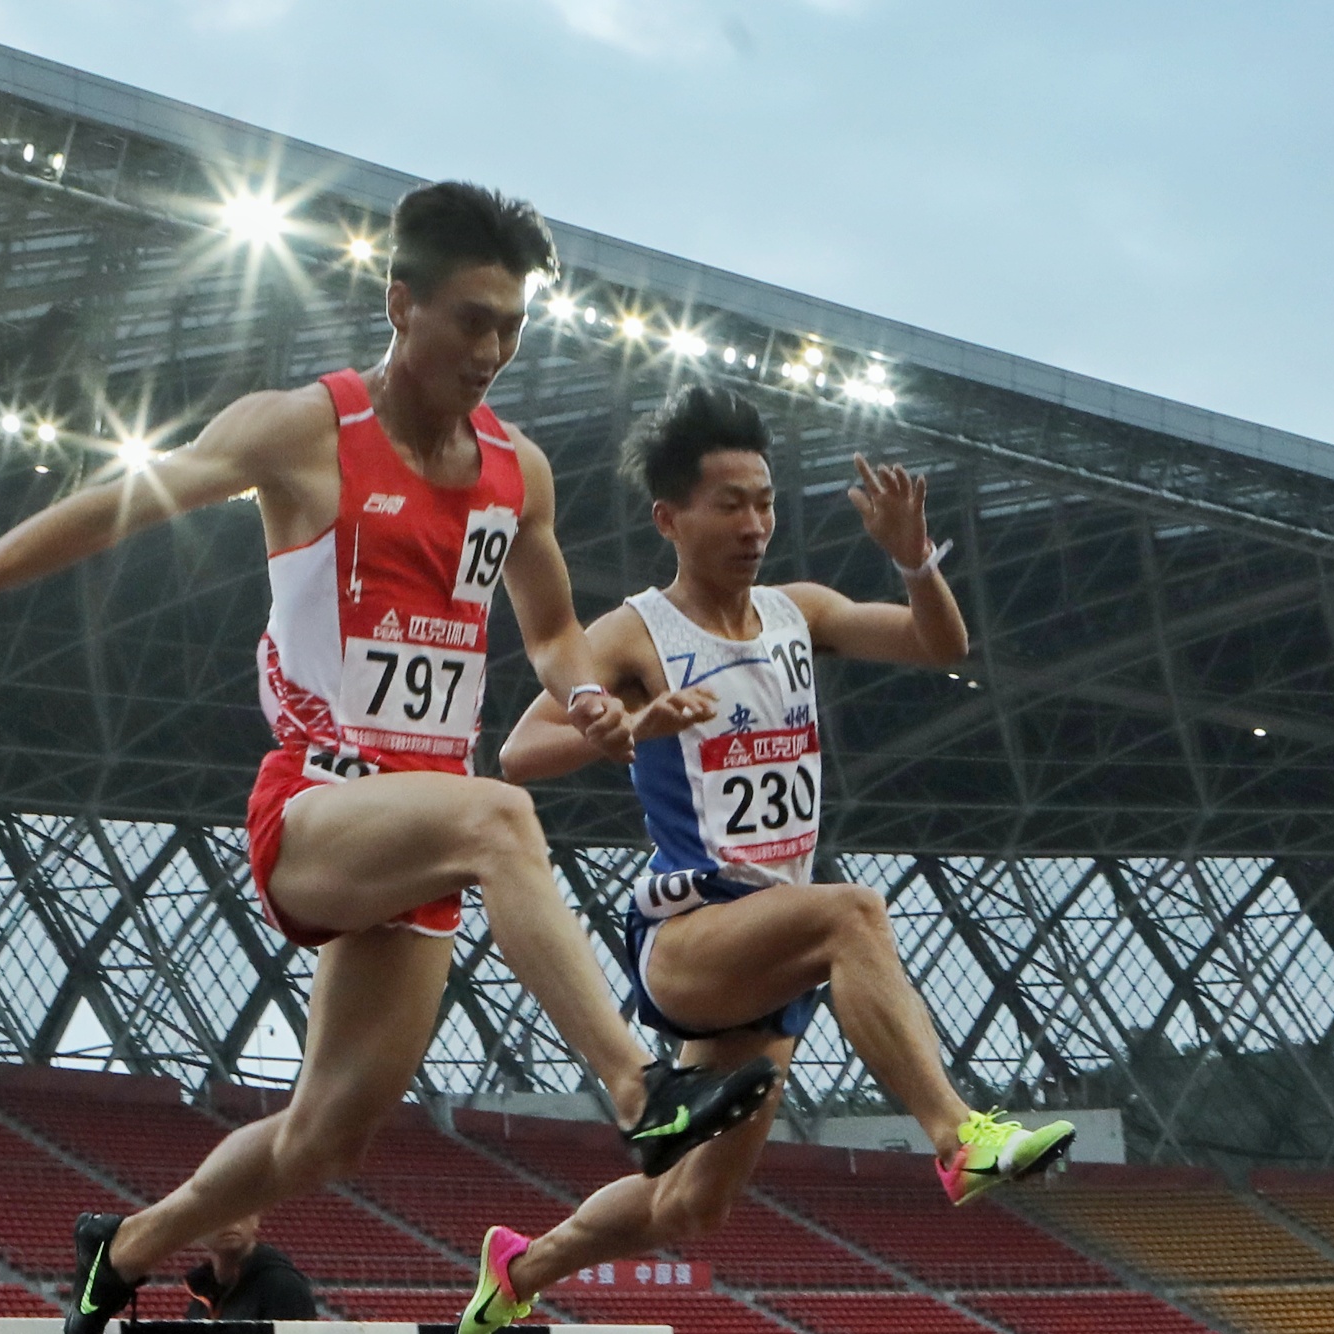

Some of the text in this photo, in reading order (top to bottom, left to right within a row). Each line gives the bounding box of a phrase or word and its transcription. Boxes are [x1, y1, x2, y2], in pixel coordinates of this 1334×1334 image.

[464, 526, 509, 588] 19
[373, 624, 405, 641] PEAK
[408, 615, 479, 648] 匹克体育
[366, 650, 465, 724] 797
[771, 640, 812, 693] 16
[723, 753, 755, 768] PEAK
[722, 765, 815, 836] 230
